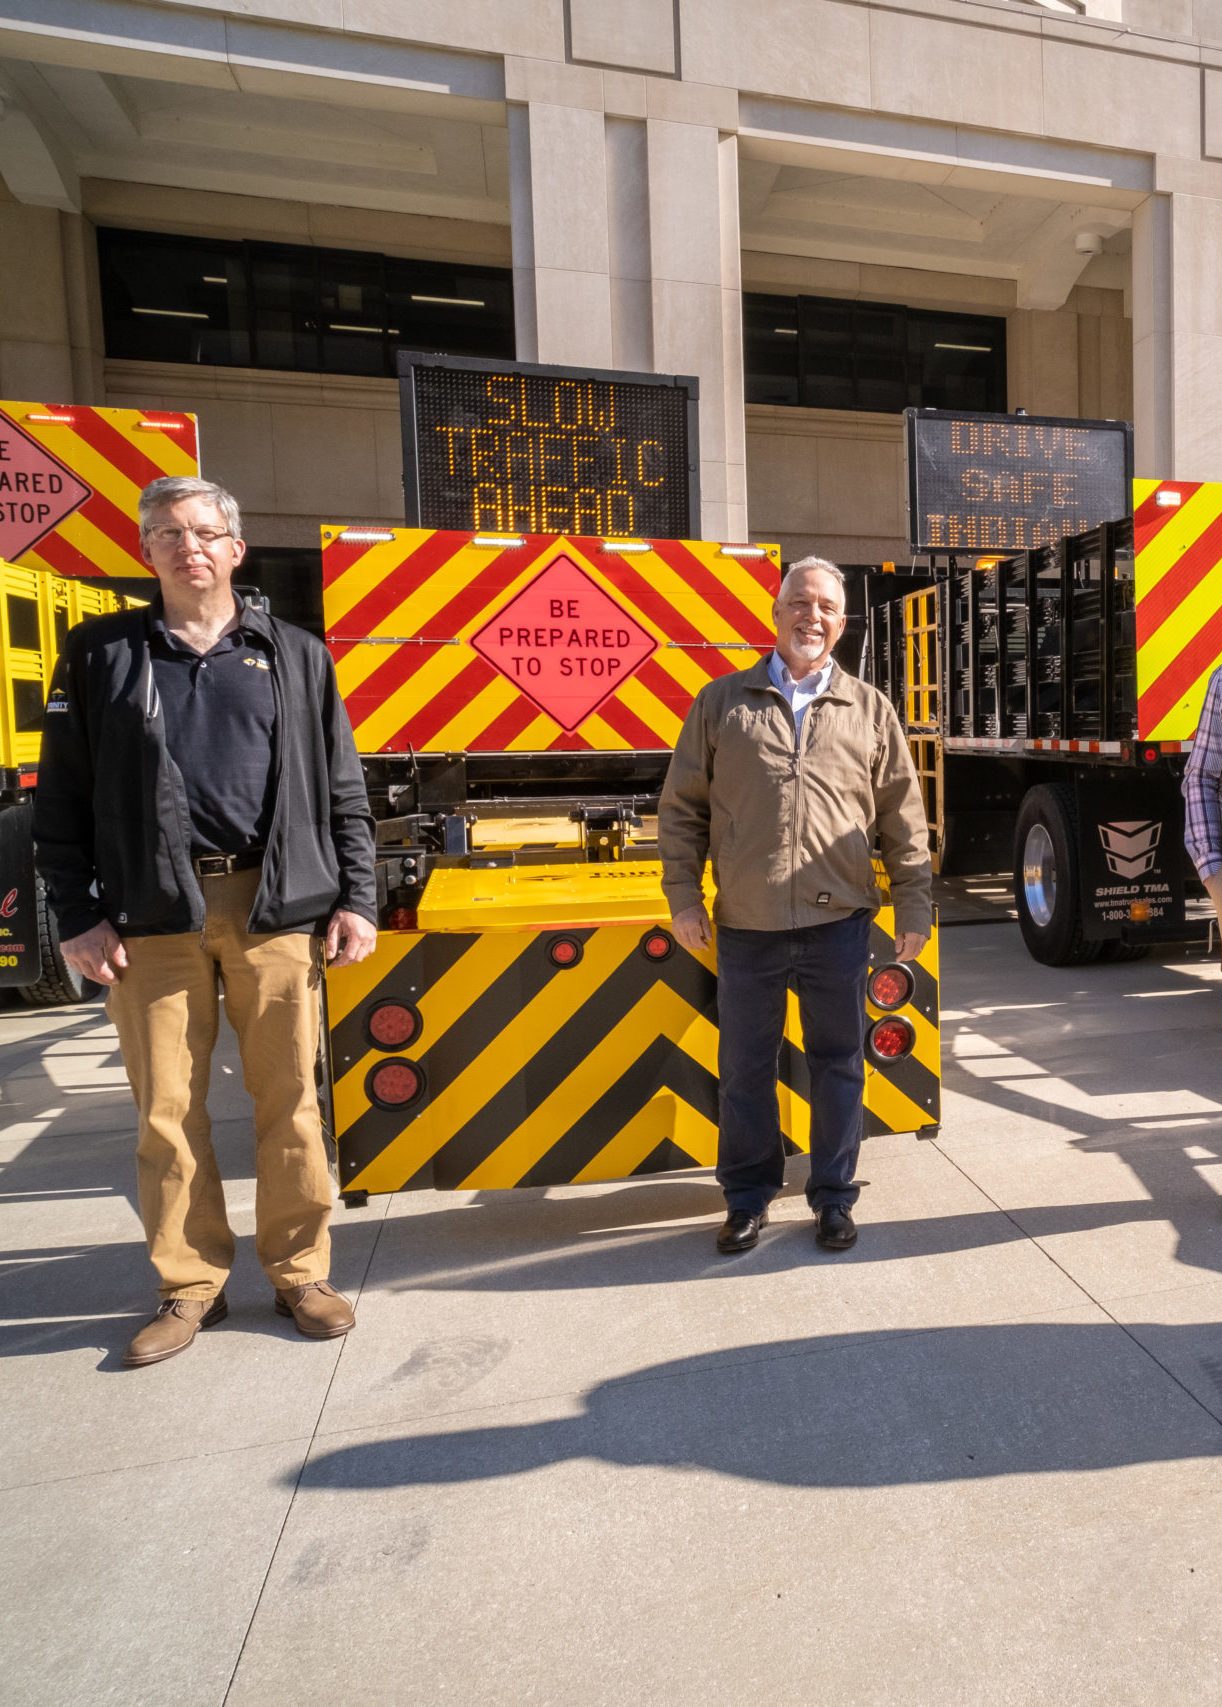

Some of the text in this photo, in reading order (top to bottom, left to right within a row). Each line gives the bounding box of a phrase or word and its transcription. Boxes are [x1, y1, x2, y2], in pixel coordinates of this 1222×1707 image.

[487, 375, 615, 432] SLOW
[0, 440, 11, 461] E
[435, 425, 665, 487] TRAFFIC
[951, 421, 1090, 461] DRIVE
[961, 468, 1080, 506] SAFE
[472, 482, 634, 537] AHEAD
[926, 513, 1104, 550] INDIAN
[550, 599, 580, 618] BE
[499, 627, 631, 648] PREPARED
[511, 657, 622, 677] TO STOP
[1095, 883, 1170, 896] SHIELD TMA
